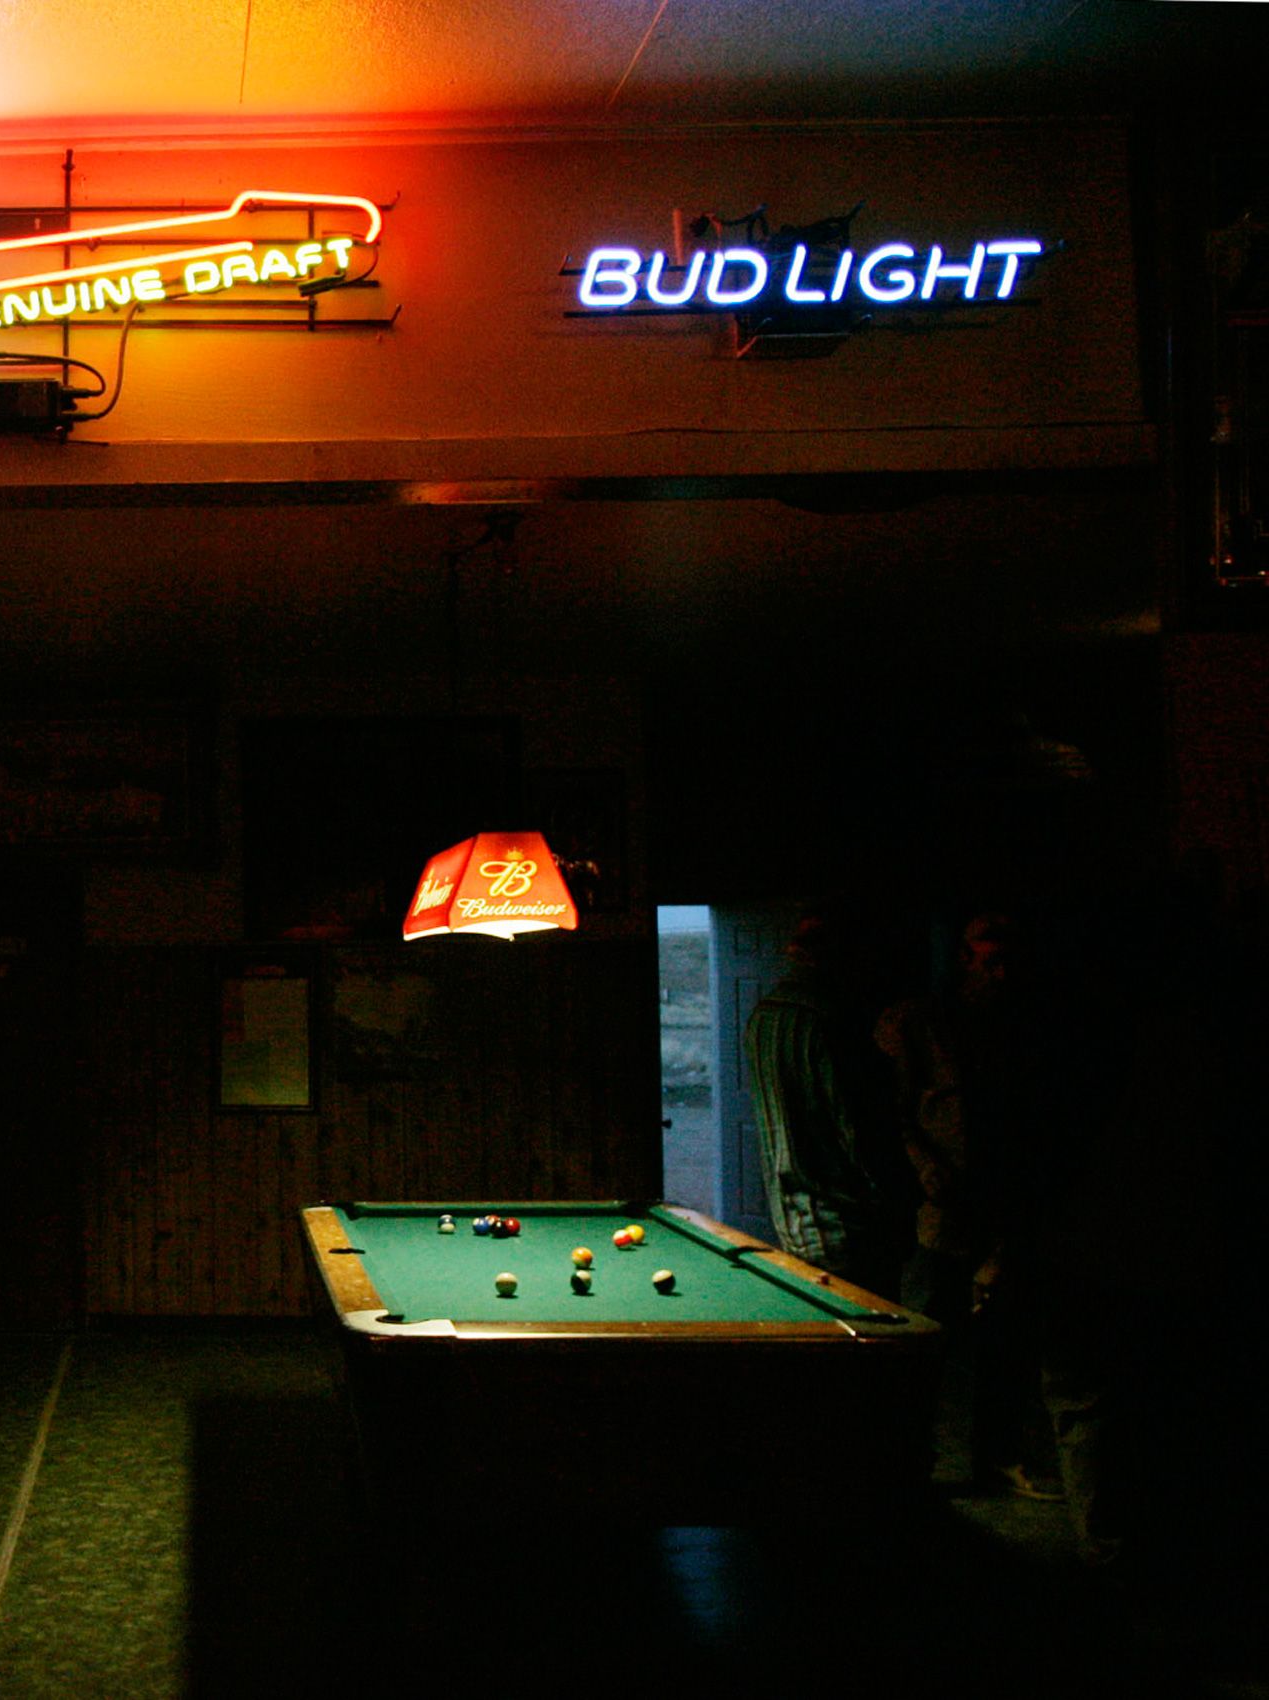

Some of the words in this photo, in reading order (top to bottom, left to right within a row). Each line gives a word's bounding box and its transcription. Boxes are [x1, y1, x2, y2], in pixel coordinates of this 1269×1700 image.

[184, 238, 352, 293] DRAFT
[579, 246, 769, 306] BUD
[785, 239, 1044, 301] LIGHT
[479, 860, 538, 897] B
[457, 898, 567, 919] Budweiser
